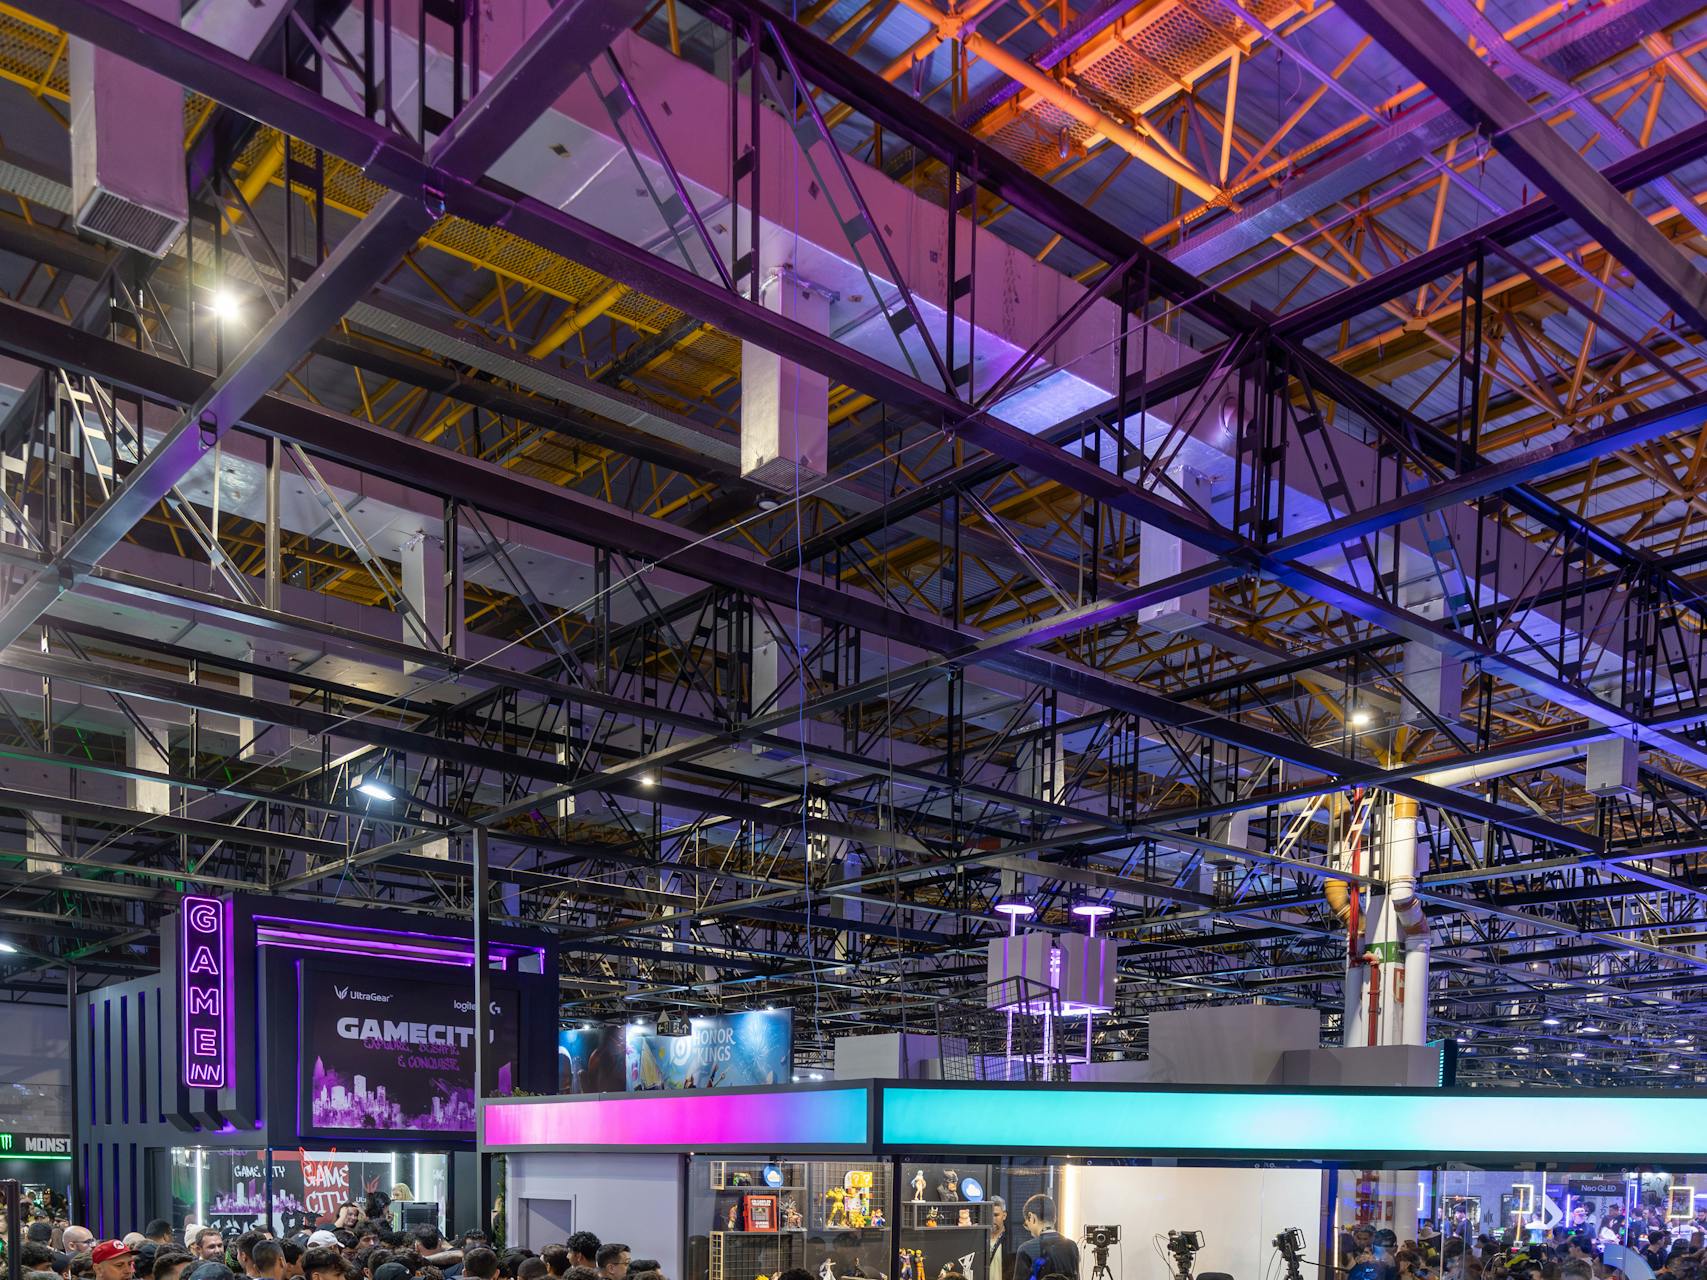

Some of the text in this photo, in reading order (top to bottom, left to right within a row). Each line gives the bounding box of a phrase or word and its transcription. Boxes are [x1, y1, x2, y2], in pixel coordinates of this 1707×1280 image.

[190, 905, 219, 1057] GAME
[350, 990, 390, 1003] UltraGear
[453, 999, 477, 1013] logite
[692, 1027, 737, 1045] HONOR
[696, 1045, 732, 1063] KINGS
[190, 1063, 221, 1081] INN
[25, 1136, 72, 1153] MONST
[234, 1164, 286, 1179] GAME CTY
[303, 1163, 350, 1189] GAME
[1581, 1184, 1617, 1193] Neo QLED
[305, 1190, 350, 1214] CITY
